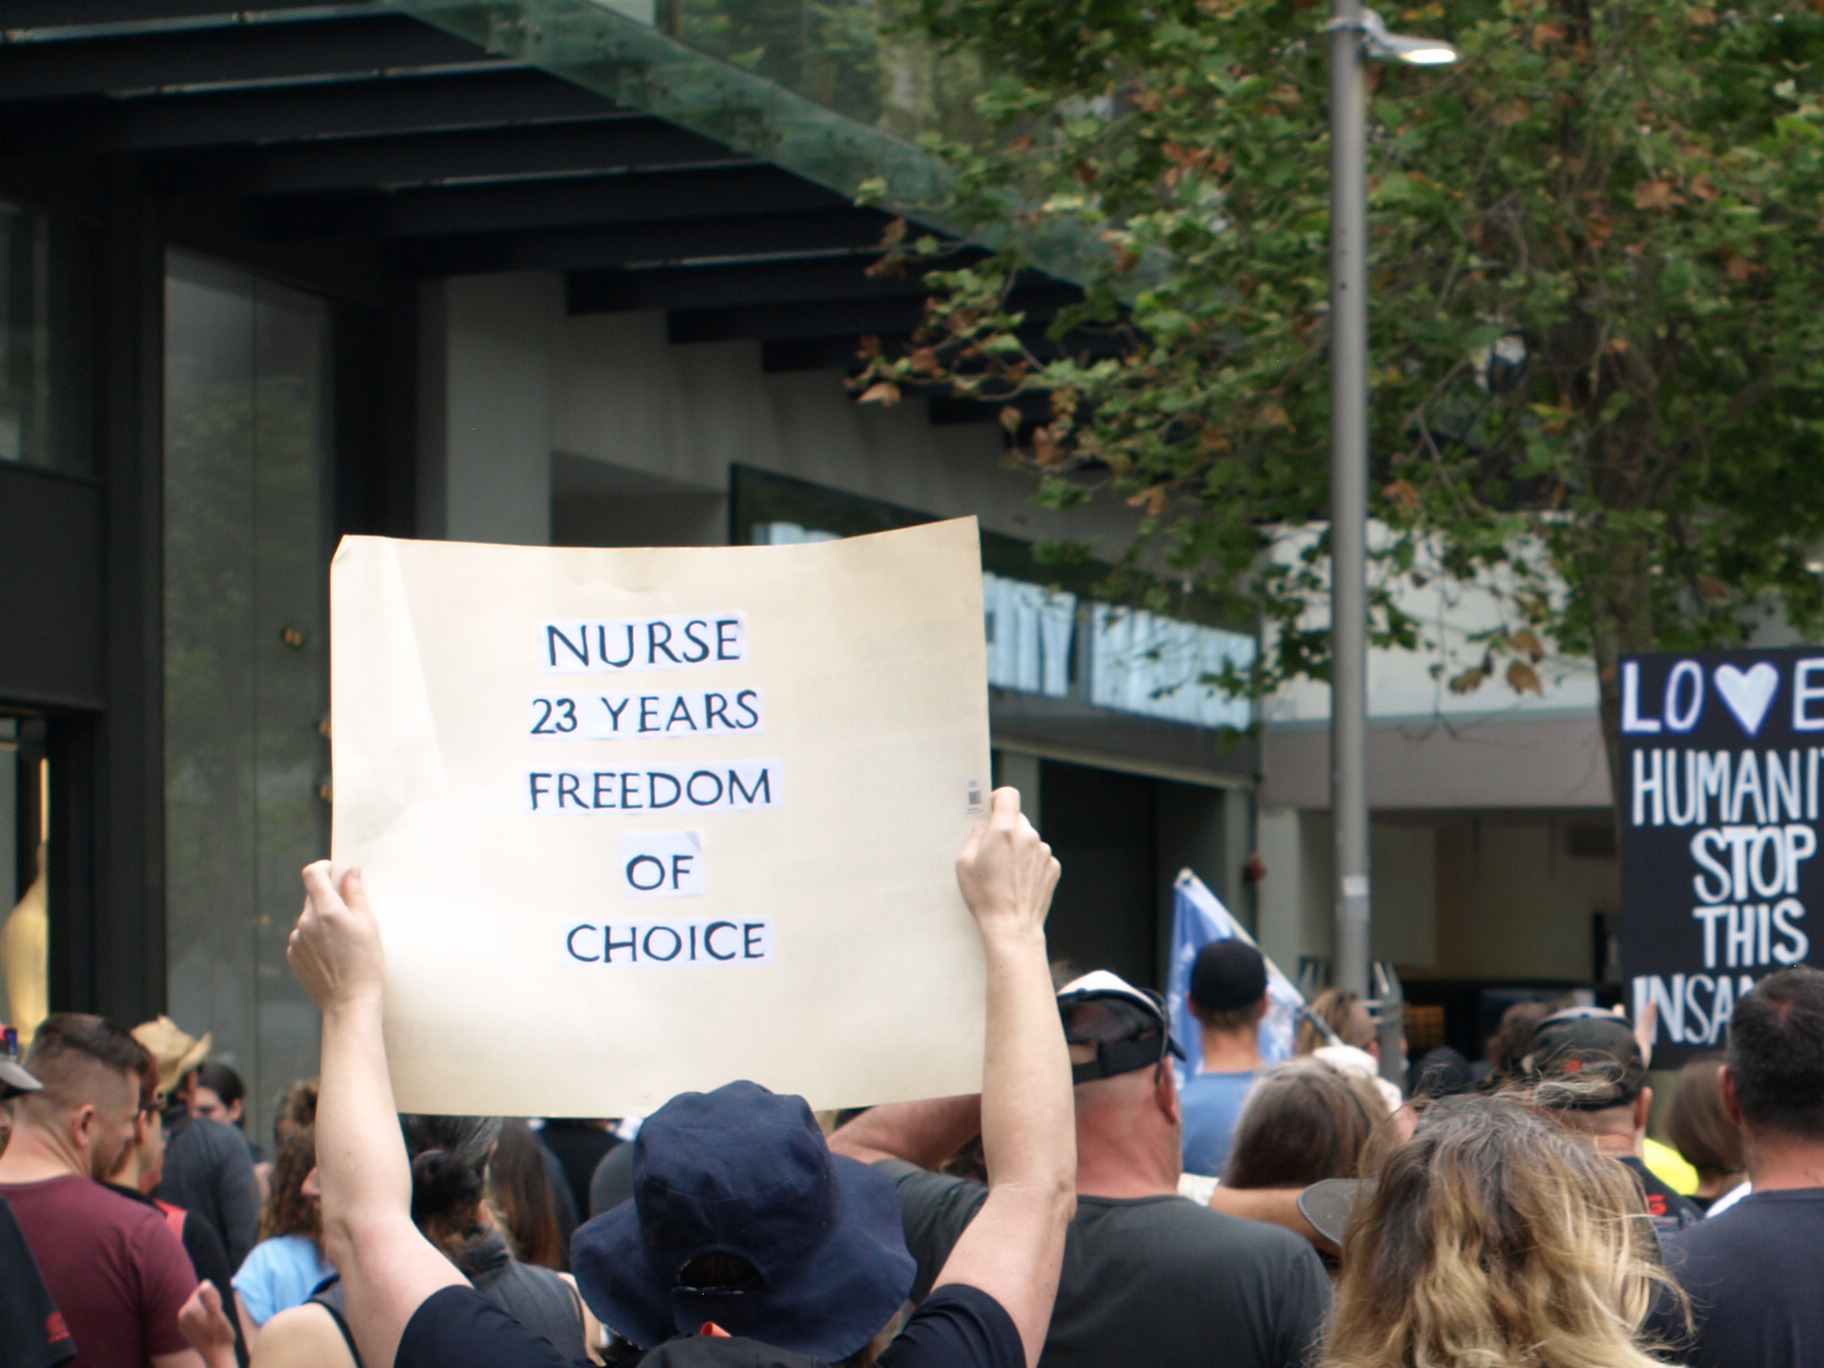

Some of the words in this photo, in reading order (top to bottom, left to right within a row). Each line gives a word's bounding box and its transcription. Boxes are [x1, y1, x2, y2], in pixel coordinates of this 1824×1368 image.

[547, 619, 742, 668] NURSE
[530, 697, 578, 735] 23
[600, 690, 760, 733] YEARS
[528, 768, 772, 811] FREEDOM
[625, 853, 695, 891] OF
[1690, 824, 1817, 904] STOP
[566, 921, 766, 963] CHOICE
[1692, 898, 1810, 969] THIS
